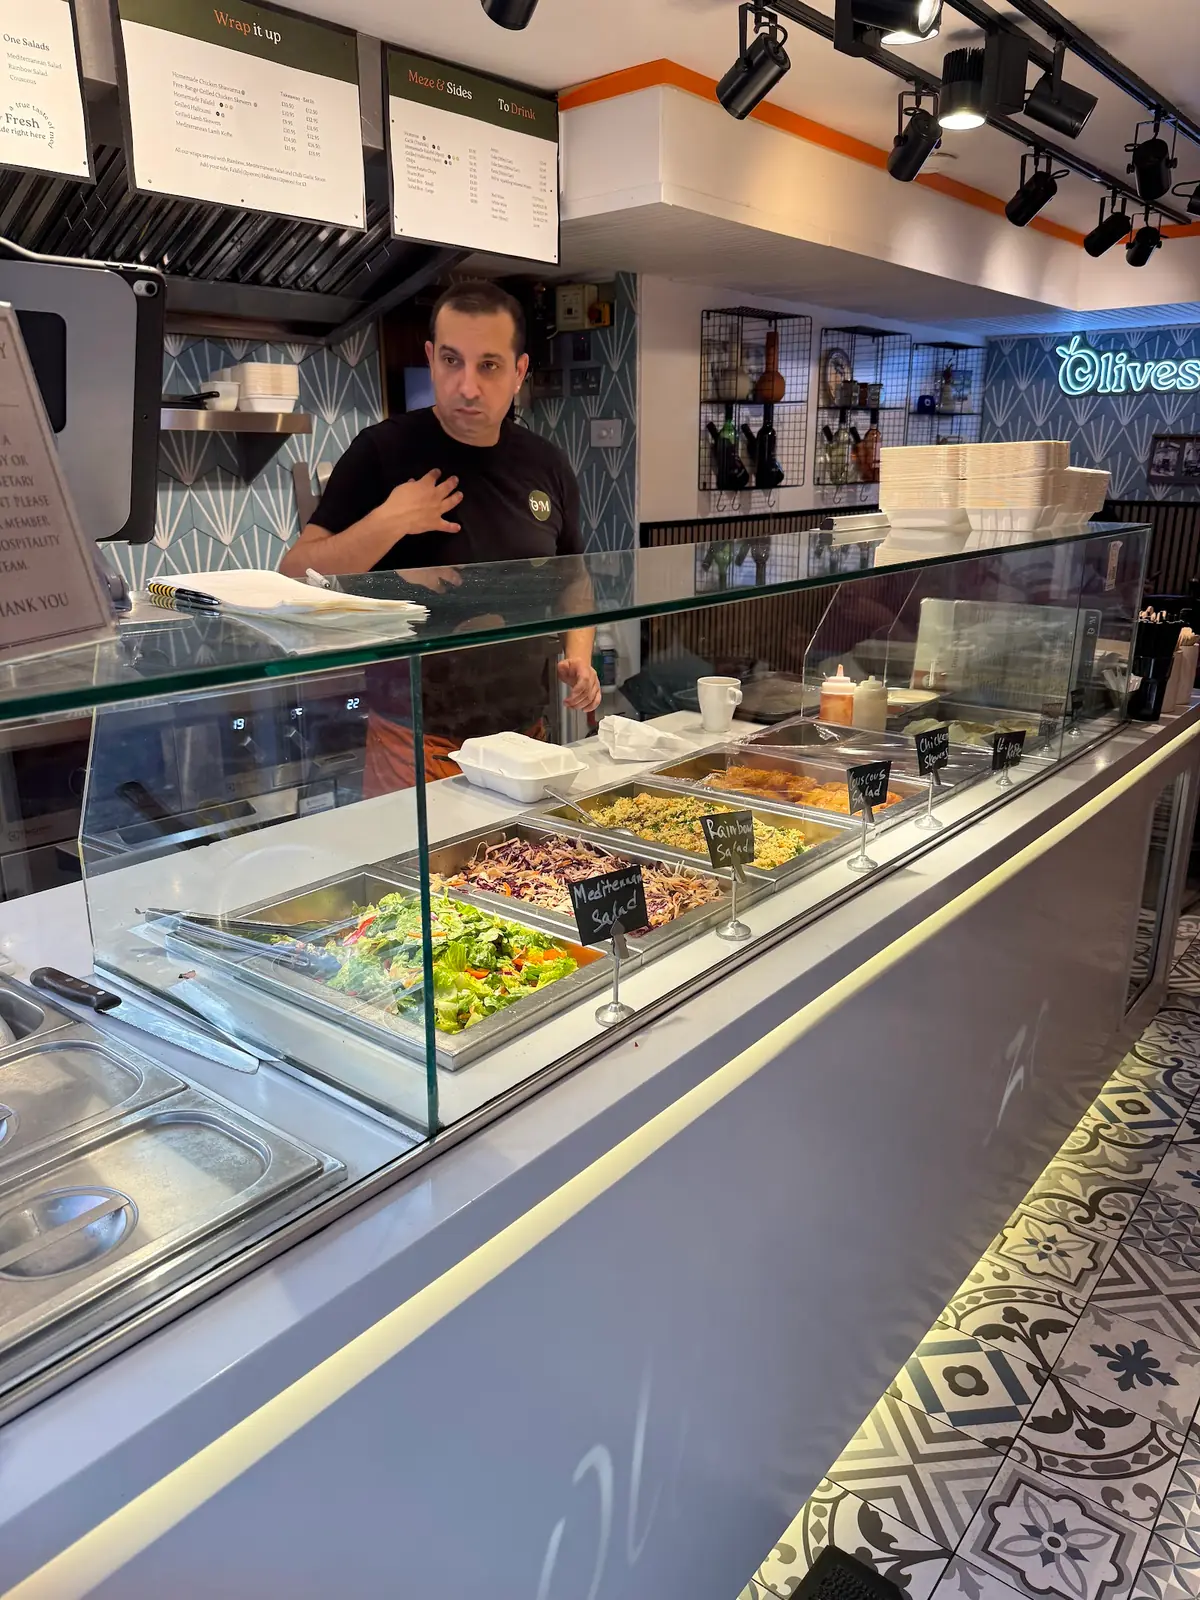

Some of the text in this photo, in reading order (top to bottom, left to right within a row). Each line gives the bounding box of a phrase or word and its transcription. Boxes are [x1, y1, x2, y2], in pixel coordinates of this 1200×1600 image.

[214, 9, 281, 44] Wrap it up
[3, 34, 50, 51] One Salads
[7, 52, 62, 69] Mediterranean Salad
[8, 63, 31, 73] Rainbow
[10, 74, 36, 85] Couscous
[408, 70, 472, 100] Meze & Sides
[32, 106, 48, 120] taste
[47, 120, 55, 129] of
[498, 98, 535, 120] To Drink
[5, 112, 40, 128] Fresh
[11, 128, 29, 137] right
[30, 130, 46, 140] here
[1057, 339, 1200, 395] Olives
[4, 434, 11, 446] A
[11, 455, 28, 466] OR
[13, 495, 50, 508] PLEASE
[5, 515, 50, 529] MEMBER
[38, 592, 69, 610] YOU
[346, 698, 360, 710] 22
[233, 718, 245, 730] 19
[706, 818, 753, 840] Rainbow
[717, 838, 749, 861] Salad
[592, 889, 637, 933] Salad
